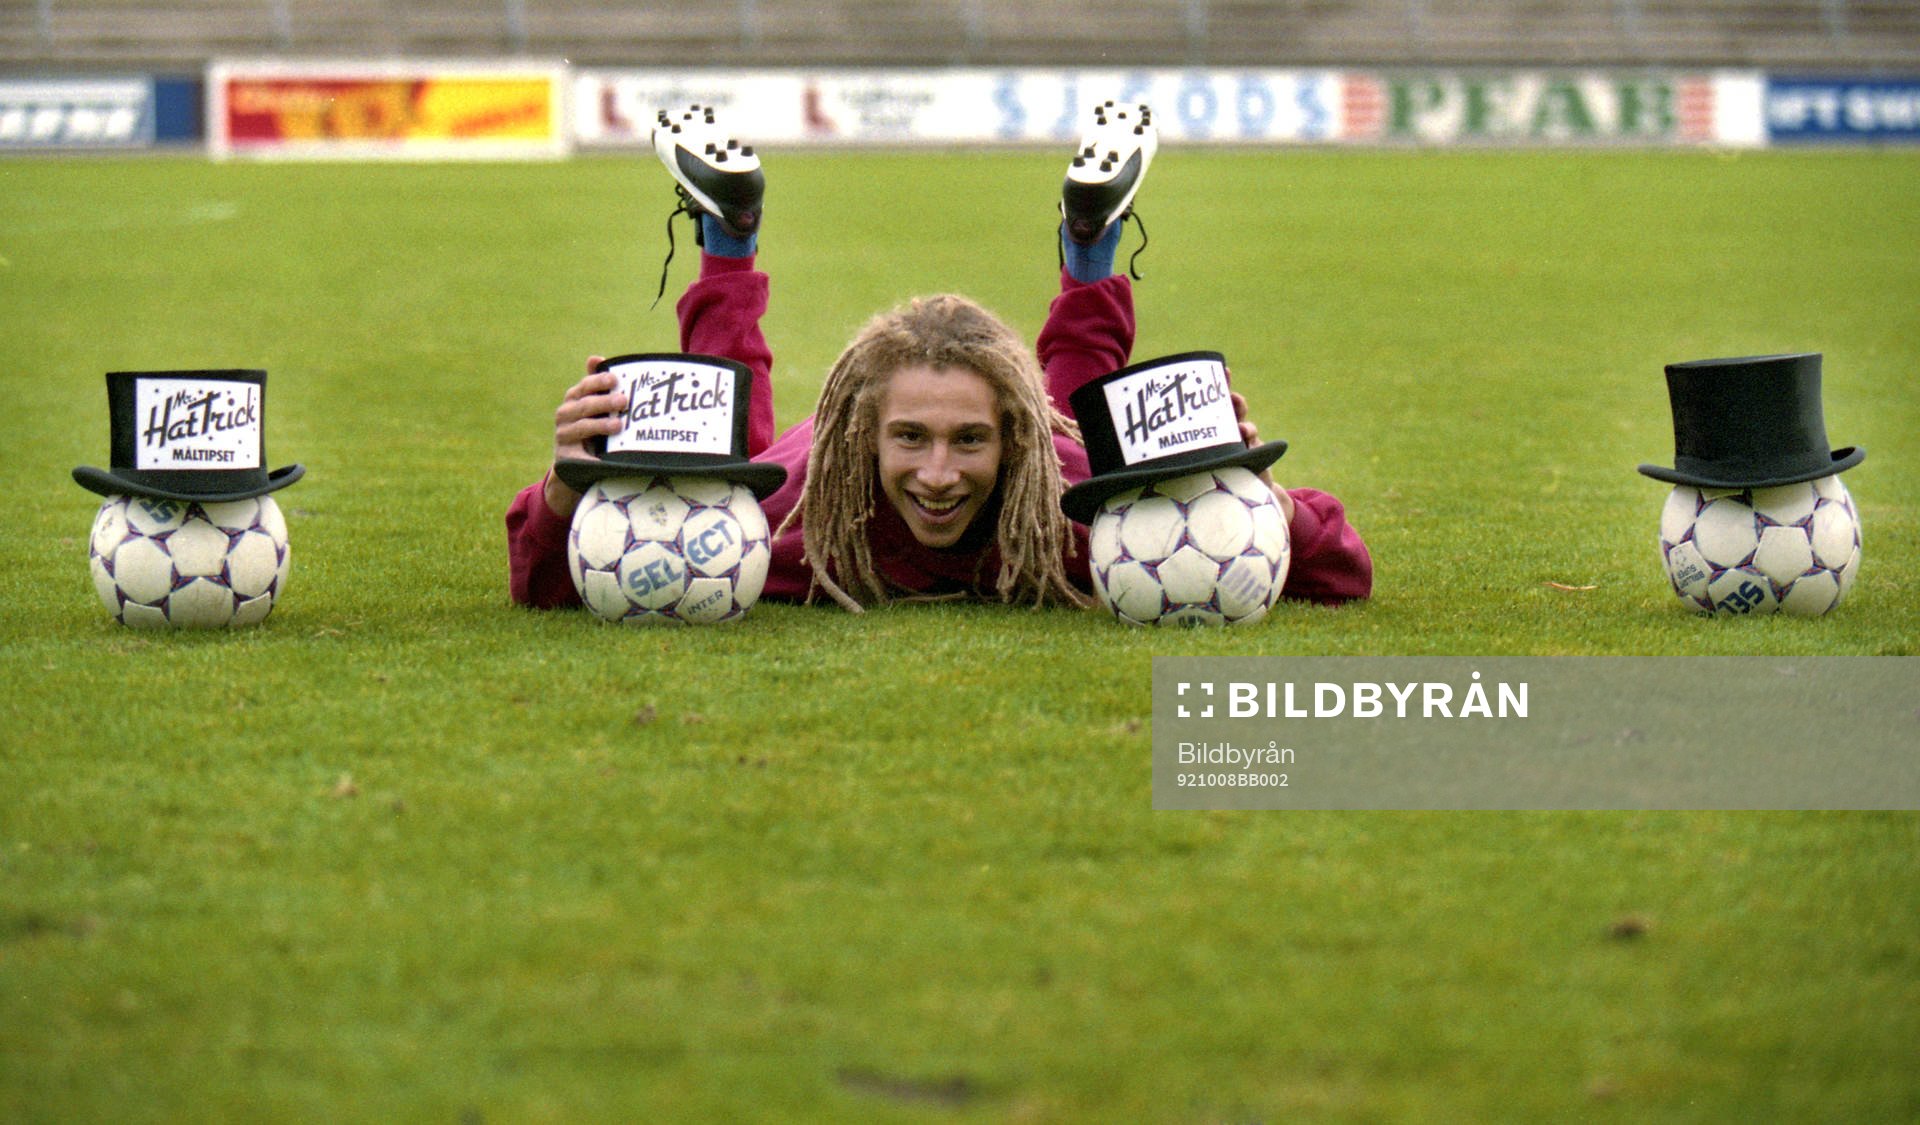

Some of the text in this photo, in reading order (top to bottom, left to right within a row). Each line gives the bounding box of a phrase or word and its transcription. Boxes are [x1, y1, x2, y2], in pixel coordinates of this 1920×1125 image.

[1388, 79, 1674, 133] PEAB
[637, 373, 660, 391] Mr.
[172, 390, 197, 409] Mr.
[636, 427, 699, 442] MÅLTIPSET
[1158, 426, 1218, 449] MÅLTIPSET
[172, 446, 235, 462] MÅLTIPSET
[687, 589, 724, 615] INTER
